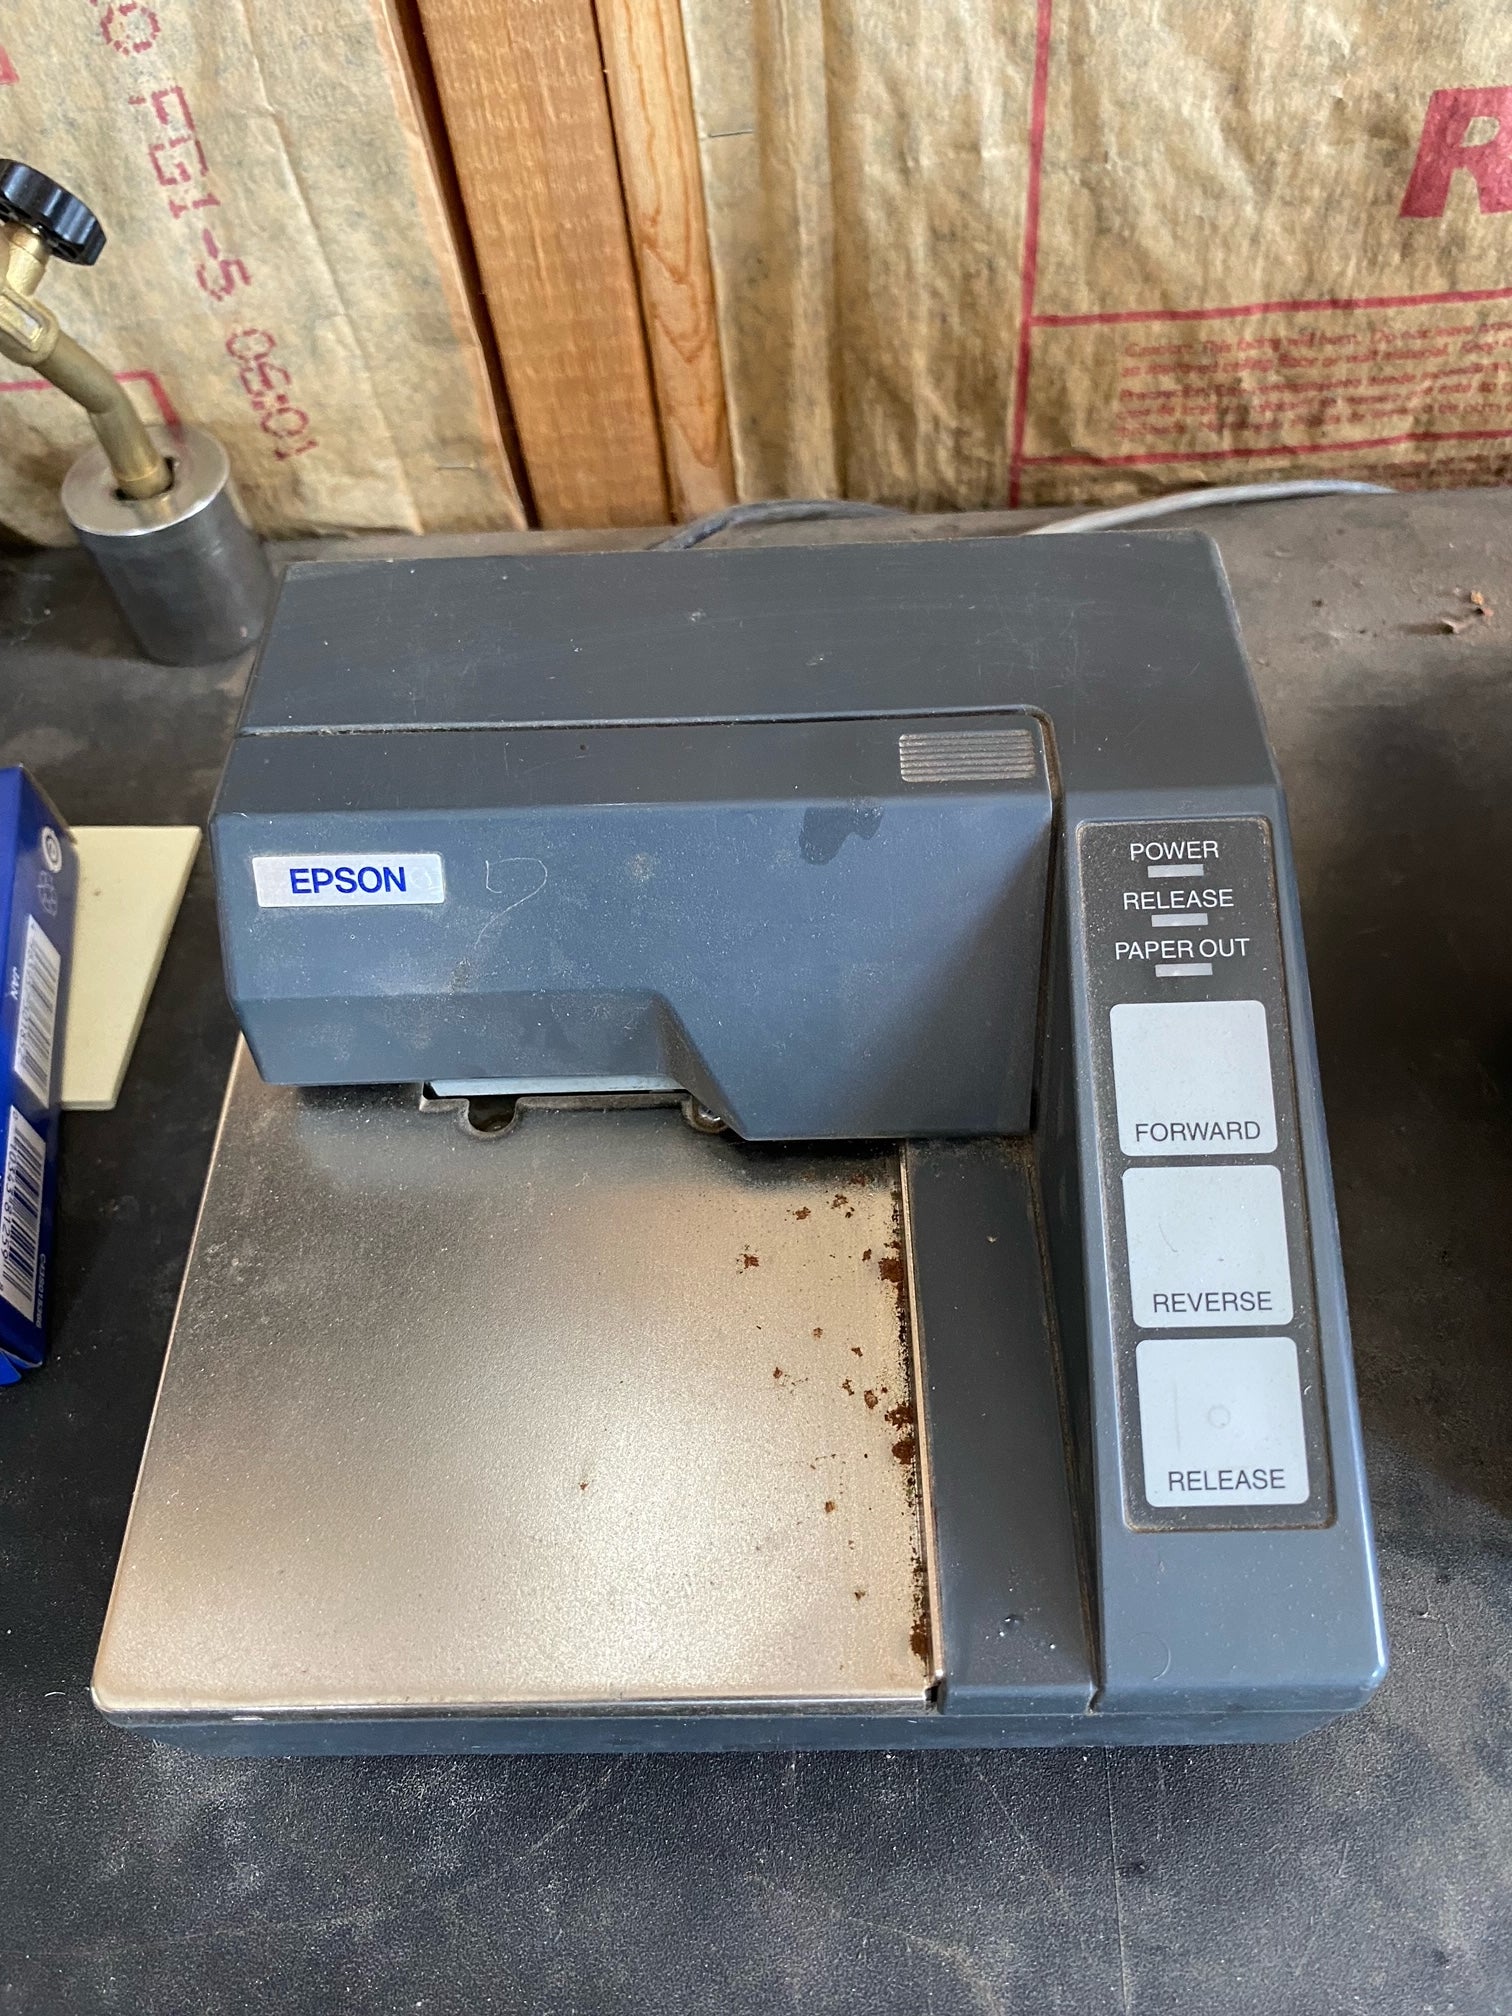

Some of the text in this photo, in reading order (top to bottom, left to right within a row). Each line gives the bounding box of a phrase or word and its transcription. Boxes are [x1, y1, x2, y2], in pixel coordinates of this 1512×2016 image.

[1130, 840, 1219, 861] POWER
[289, 866, 407, 894] EPSON
[1123, 888, 1234, 910] RELEASE
[1115, 938, 1250, 960] PAPER OUT
[1135, 1121, 1261, 1142] FORWARD
[1153, 1291, 1273, 1313] REVERSE
[1168, 1468, 1286, 1491] RELEASE
